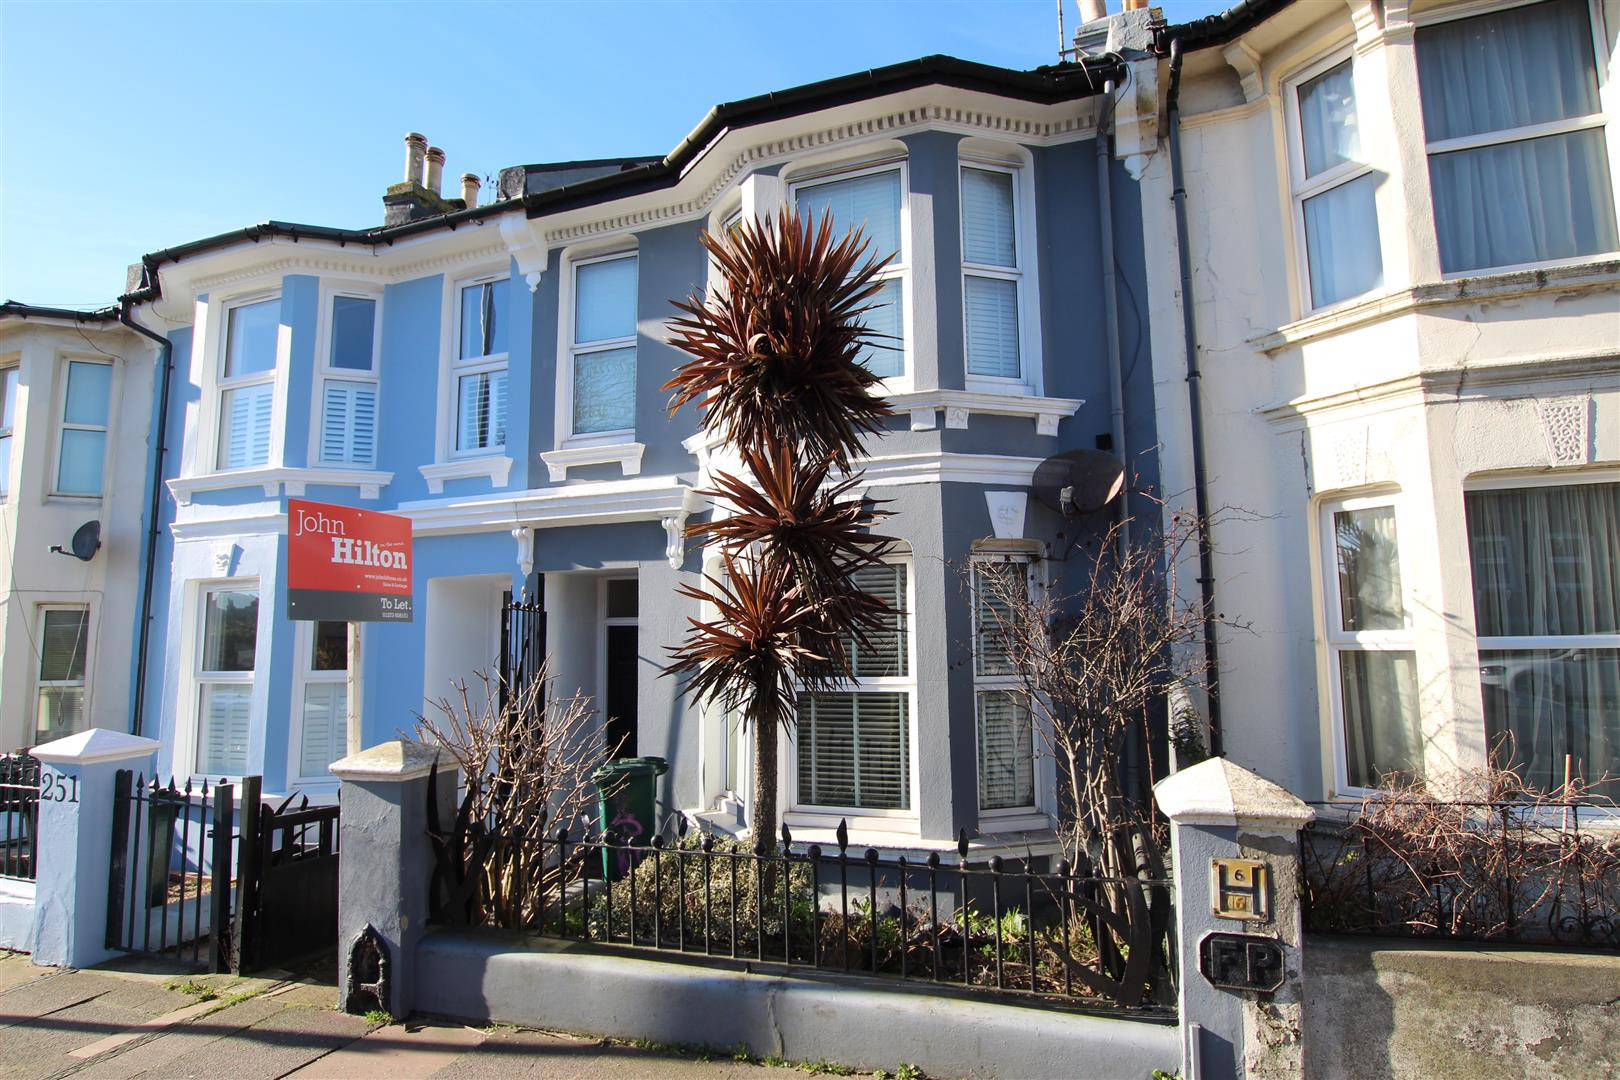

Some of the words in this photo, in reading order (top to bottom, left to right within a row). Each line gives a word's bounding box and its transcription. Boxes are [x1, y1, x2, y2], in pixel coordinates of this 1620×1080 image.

[296, 509, 346, 536] John
[331, 537, 408, 569] Hilton
[380, 597, 393, 609] To
[41, 772, 79, 803] 251
[1234, 869, 1245, 881] 6
[1210, 939, 1274, 983] FP
